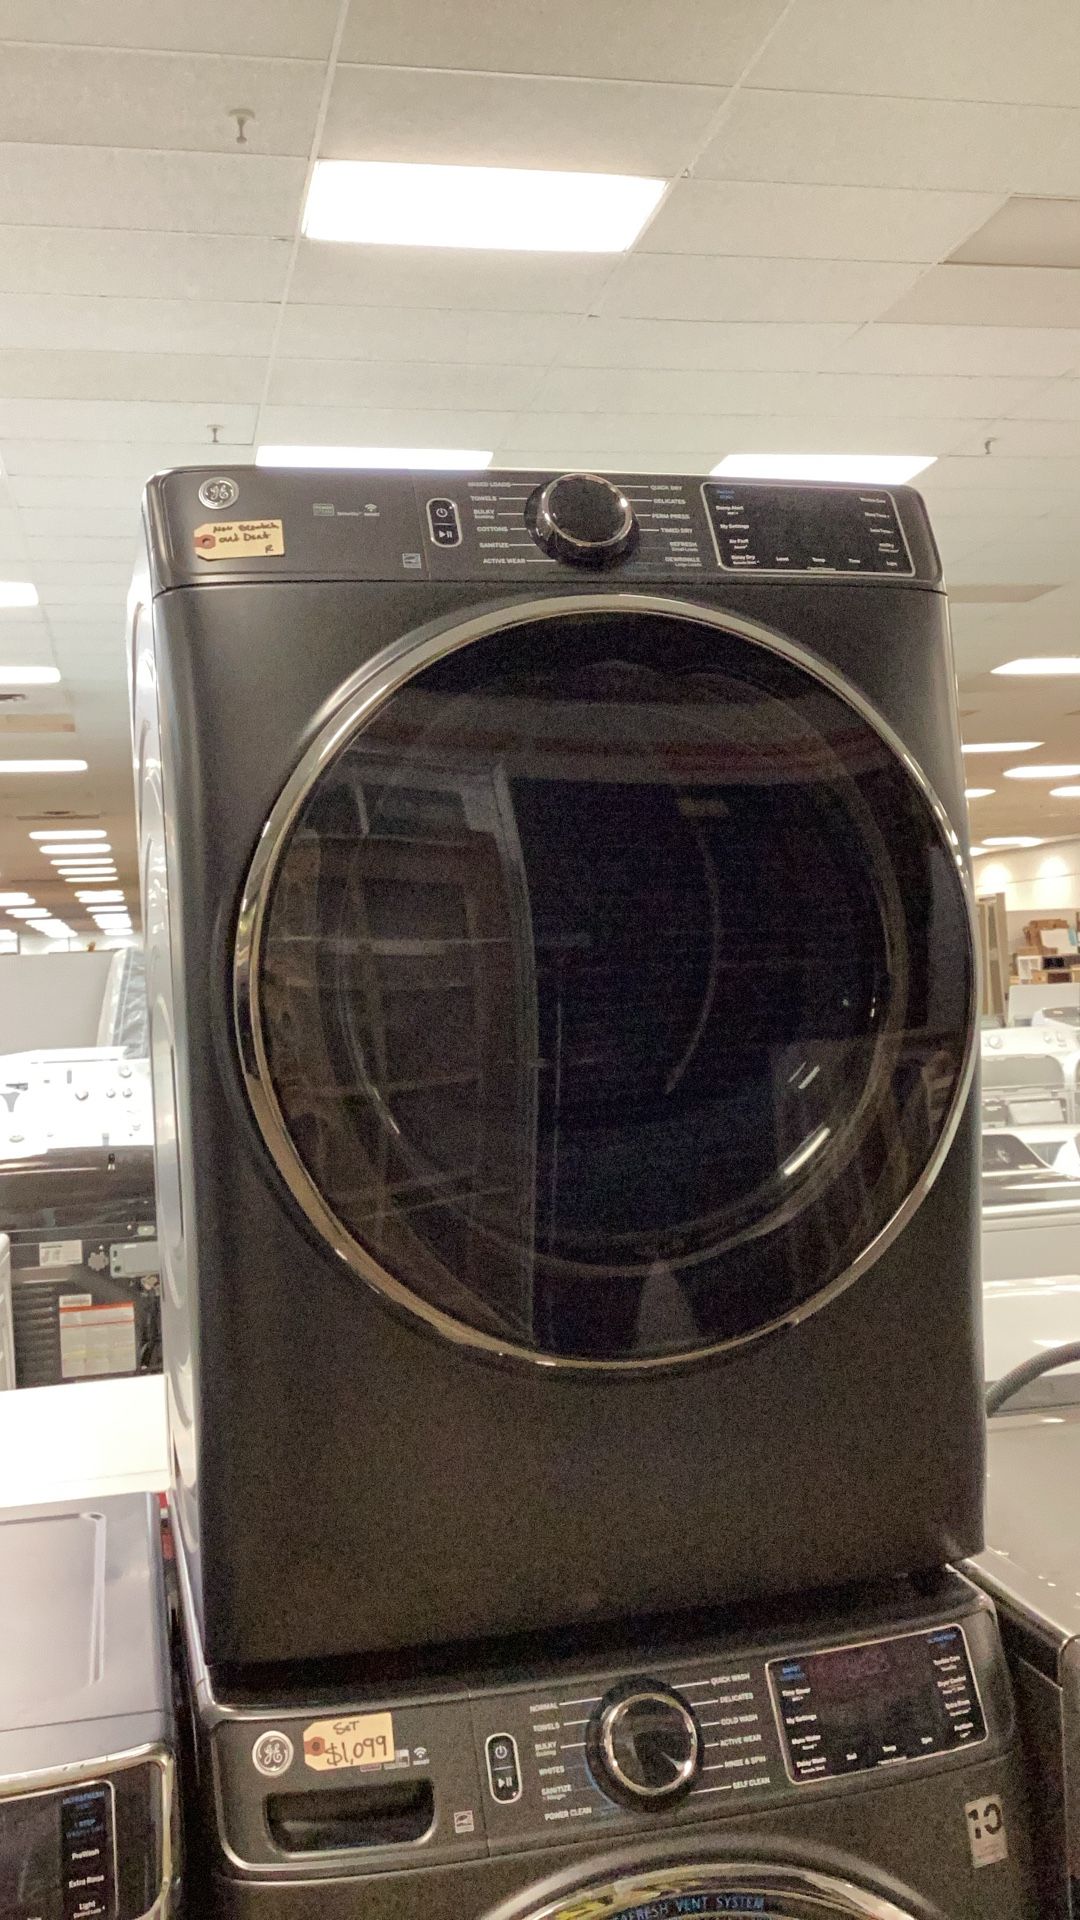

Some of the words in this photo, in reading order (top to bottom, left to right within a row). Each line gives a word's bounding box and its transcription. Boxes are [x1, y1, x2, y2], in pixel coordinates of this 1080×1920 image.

[720, 1692, 754, 1703] DELICATES
[530, 1703, 559, 1713] NORMAL
[533, 1721, 560, 1732] TOWELS
[720, 1716, 739, 1726] COLD
[324, 1735, 387, 1767] $1,099
[732, 1780, 748, 1790] SELF
[748, 1776, 771, 1787] CLEAN
[541, 1783, 572, 1796] SANITIZE
[569, 1806, 593, 1817] CLEAN
[716, 1894, 765, 1910] SYSTEM
